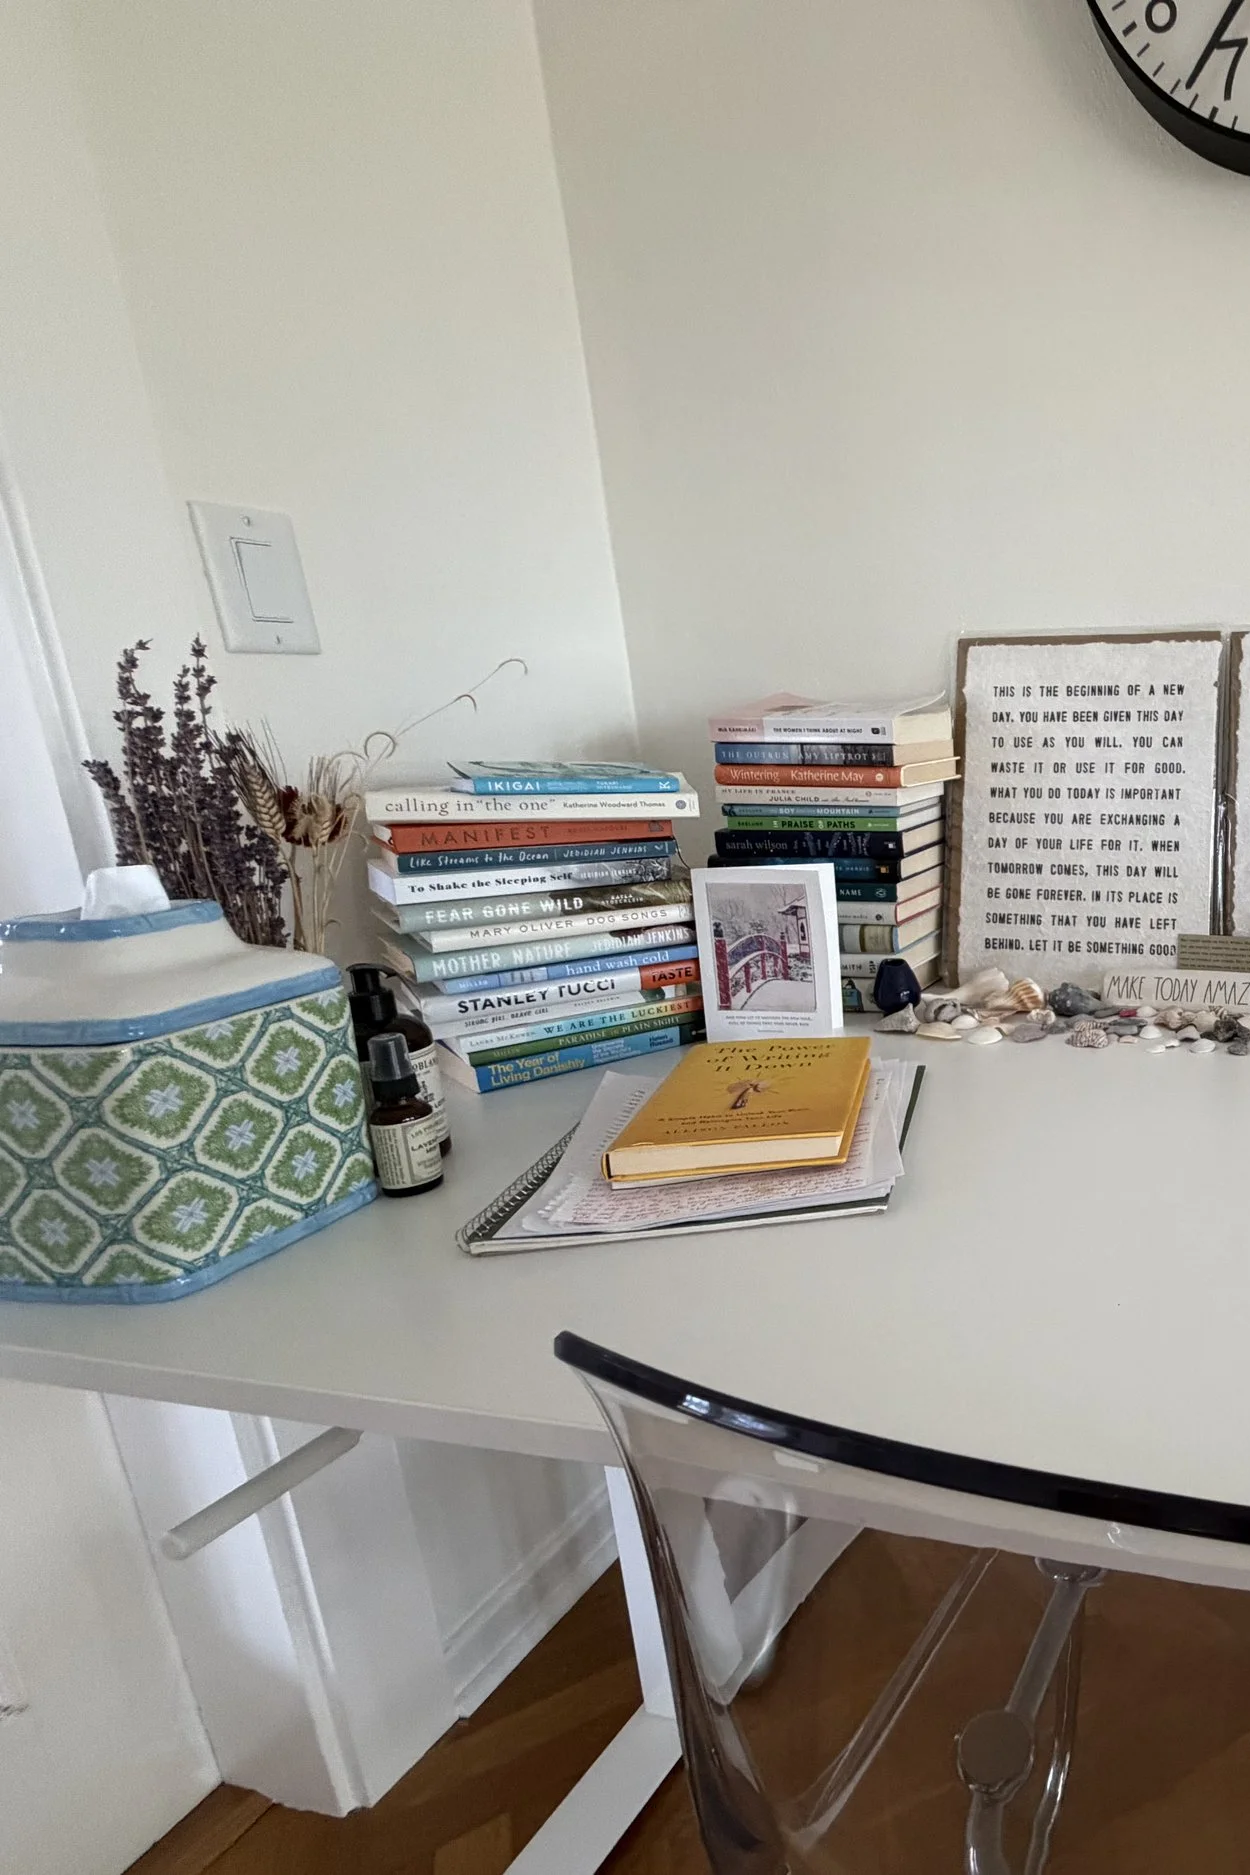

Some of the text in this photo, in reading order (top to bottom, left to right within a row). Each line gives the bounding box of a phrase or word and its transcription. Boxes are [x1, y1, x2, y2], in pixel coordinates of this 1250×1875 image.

[1213, 37, 1248, 101] 7
[994, 684, 1184, 697] THIS IS THE BEGINNING OF A NEW
[992, 710, 1183, 723] DAY. YOU HAVE BEEN GIVEN THIS DAY
[992, 736, 1182, 748] TO USE AS YOU WILL. YOU CAN
[730, 770, 864, 783] Wintering Katherine May
[991, 762, 1185, 774] WASTE IT OR USE IT FOR GOOD.
[488, 781, 540, 791] IKIGAI
[385, 798, 449, 816] calling
[456, 800, 474, 812] in
[826, 821, 856, 829] PATHS
[421, 826, 550, 846] MANIFEST
[725, 840, 752, 850] sarah
[754, 840, 788, 850] wilson
[438, 856, 478, 867] Streams
[484, 854, 493, 862] to
[498, 852, 514, 862] the
[519, 852, 549, 862] Ocean
[564, 846, 647, 858] JEDIDIAH JENKINS
[988, 862, 1178, 878] TOMORROW COMES, THIS DAY WILL
[408, 885, 424, 893] To
[428, 881, 467, 890] Shake
[472, 878, 491, 888] the
[495, 874, 546, 887] Sleeping
[550, 872, 573, 882] Self
[425, 907, 474, 925] FEAR
[482, 902, 531, 919] GONE
[540, 896, 584, 913] WILD
[470, 910, 668, 939] MARY OLIVER DOG SONGS
[986, 912, 1176, 930] SOMETHING THAT YOU HAVE LEFT
[512, 942, 572, 964] NATURE
[591, 934, 644, 952] JEDIDIAH
[646, 928, 690, 946] JENKINS
[985, 938, 1177, 956] BEHIND. LET IT BE SOMETHING GOOD
[566, 950, 670, 976] hand wash cold
[458, 966, 693, 1014] STANLEY TUCCI TASTE
[1106, 976, 1146, 1000] MAKE
[1154, 976, 1198, 1002] TODAY
[544, 1024, 564, 1034] WE
[570, 1019, 594, 1031] ARE
[600, 1013, 626, 1026] THE
[632, 1001, 690, 1018] LUCKIEST
[558, 1032, 606, 1046] PARADISE
[622, 1023, 650, 1036] PLAIN
[488, 1052, 560, 1075] The Year of
[491, 1057, 586, 1086] Living Danishly
